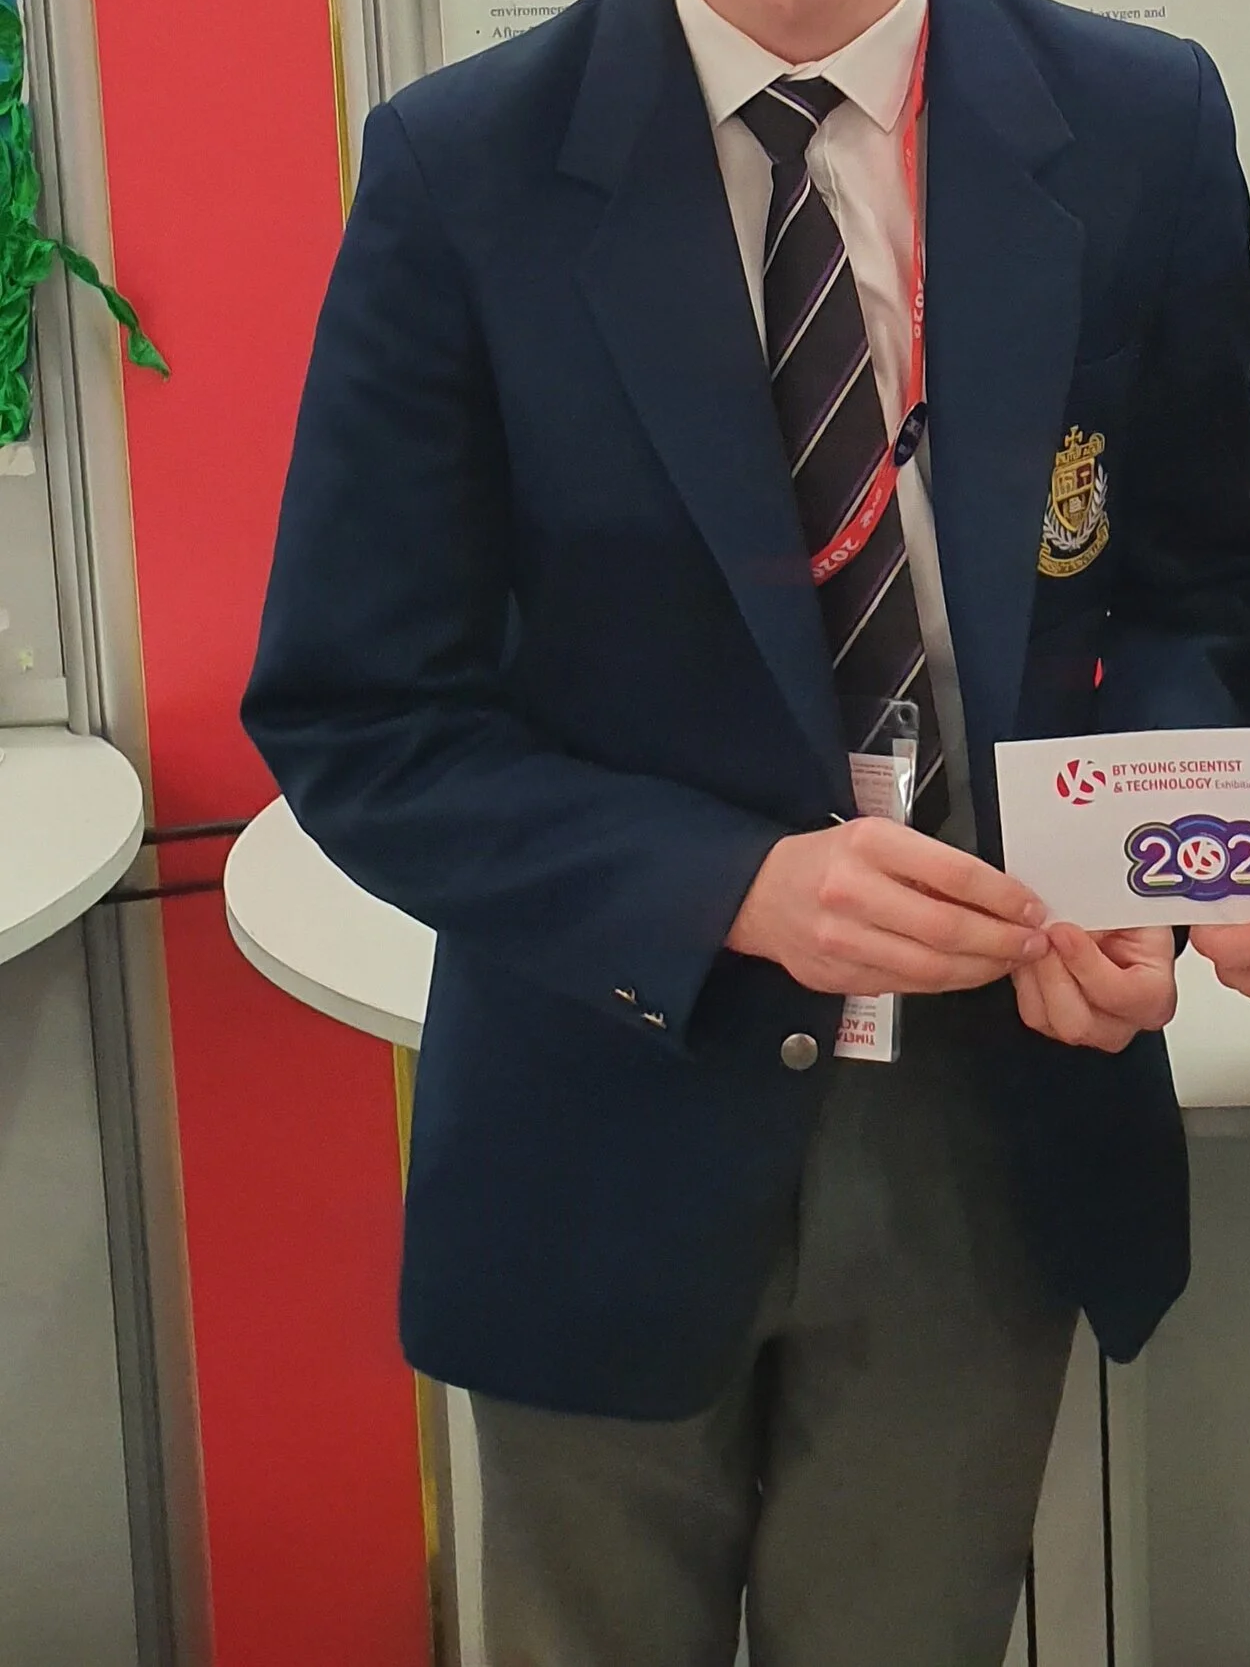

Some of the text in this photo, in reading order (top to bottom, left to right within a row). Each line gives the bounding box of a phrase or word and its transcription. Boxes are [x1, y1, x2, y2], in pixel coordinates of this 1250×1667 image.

[1112, 760, 1242, 776] BT YOUNG SCIENTIST
[1113, 782, 1123, 793] &
[1126, 778, 1212, 792] TECHNOLOGY
